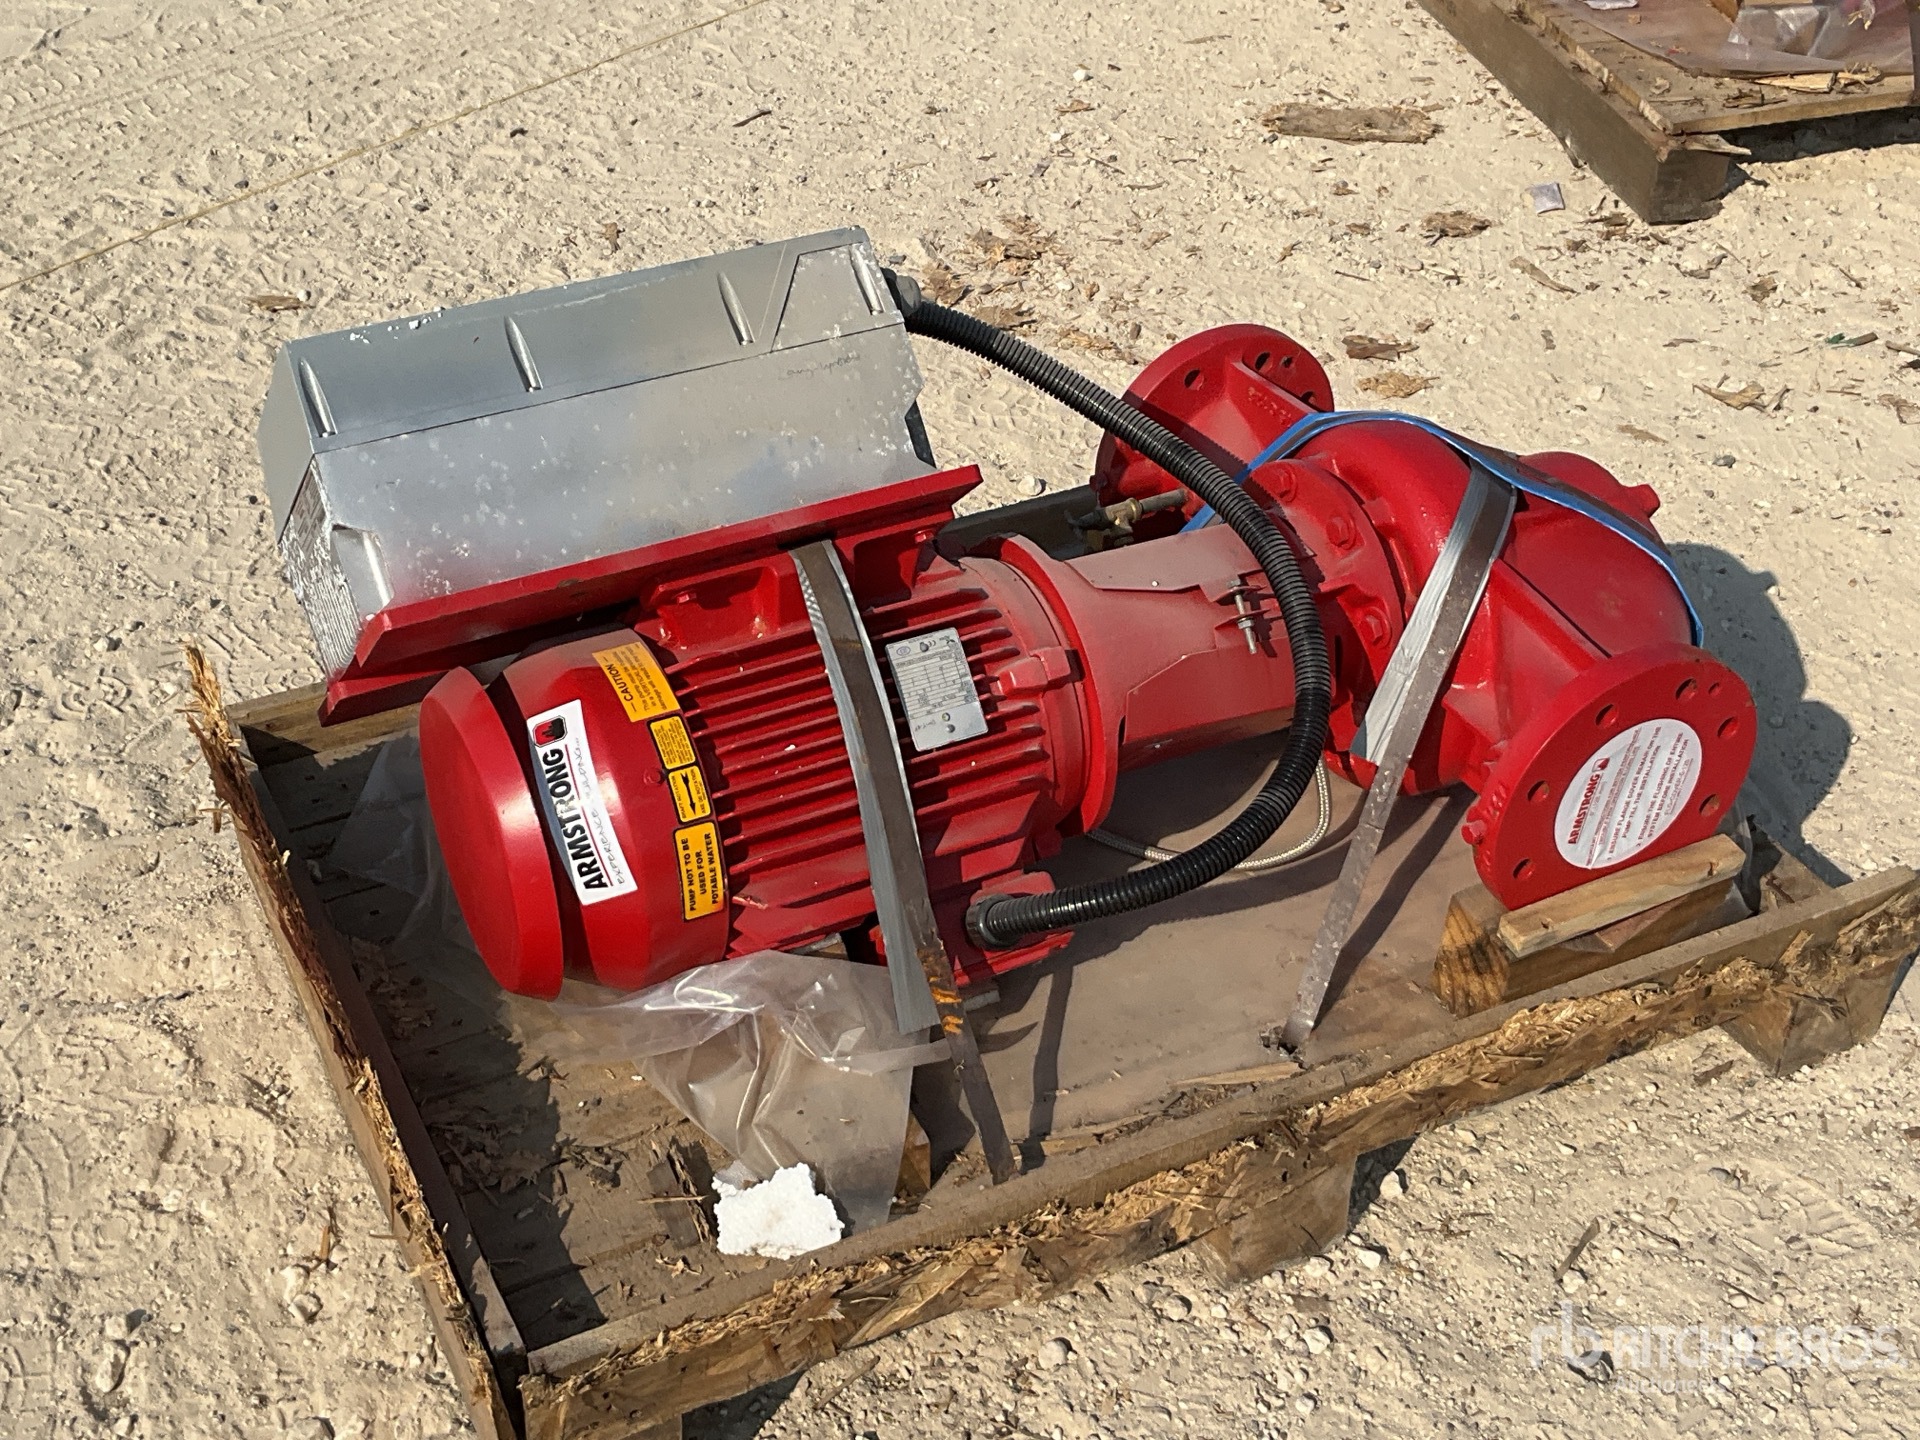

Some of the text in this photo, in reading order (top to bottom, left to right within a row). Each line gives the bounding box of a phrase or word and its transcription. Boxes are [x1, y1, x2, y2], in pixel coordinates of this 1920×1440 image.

[604, 663, 635, 702] CAUTION
[671, 775, 681, 801] ROTATION
[689, 768, 701, 794] ROTATION
[1567, 774, 1600, 843] ARMSTRONG
[1608, 827, 1620, 852] ENSURE
[1616, 800, 1630, 825] FLANGE
[1626, 776, 1639, 797] COVER
[1646, 740, 1654, 749] ON
[1651, 726, 1661, 738] THE
[1621, 745, 1660, 837] PUMP TILL THE INSTALLATION
[1647, 800, 1656, 811] THE
[1652, 767, 1668, 798] FLUSHING
[1656, 786, 1670, 810] BEFORE
[1667, 739, 1688, 783] INSTALLATION
[542, 747, 607, 888] ARMSTRONG
[680, 837, 696, 911] PUMP NOT TO BE
[695, 849, 706, 894] USED FOR
[704, 832, 719, 904] POTABLE WATER
